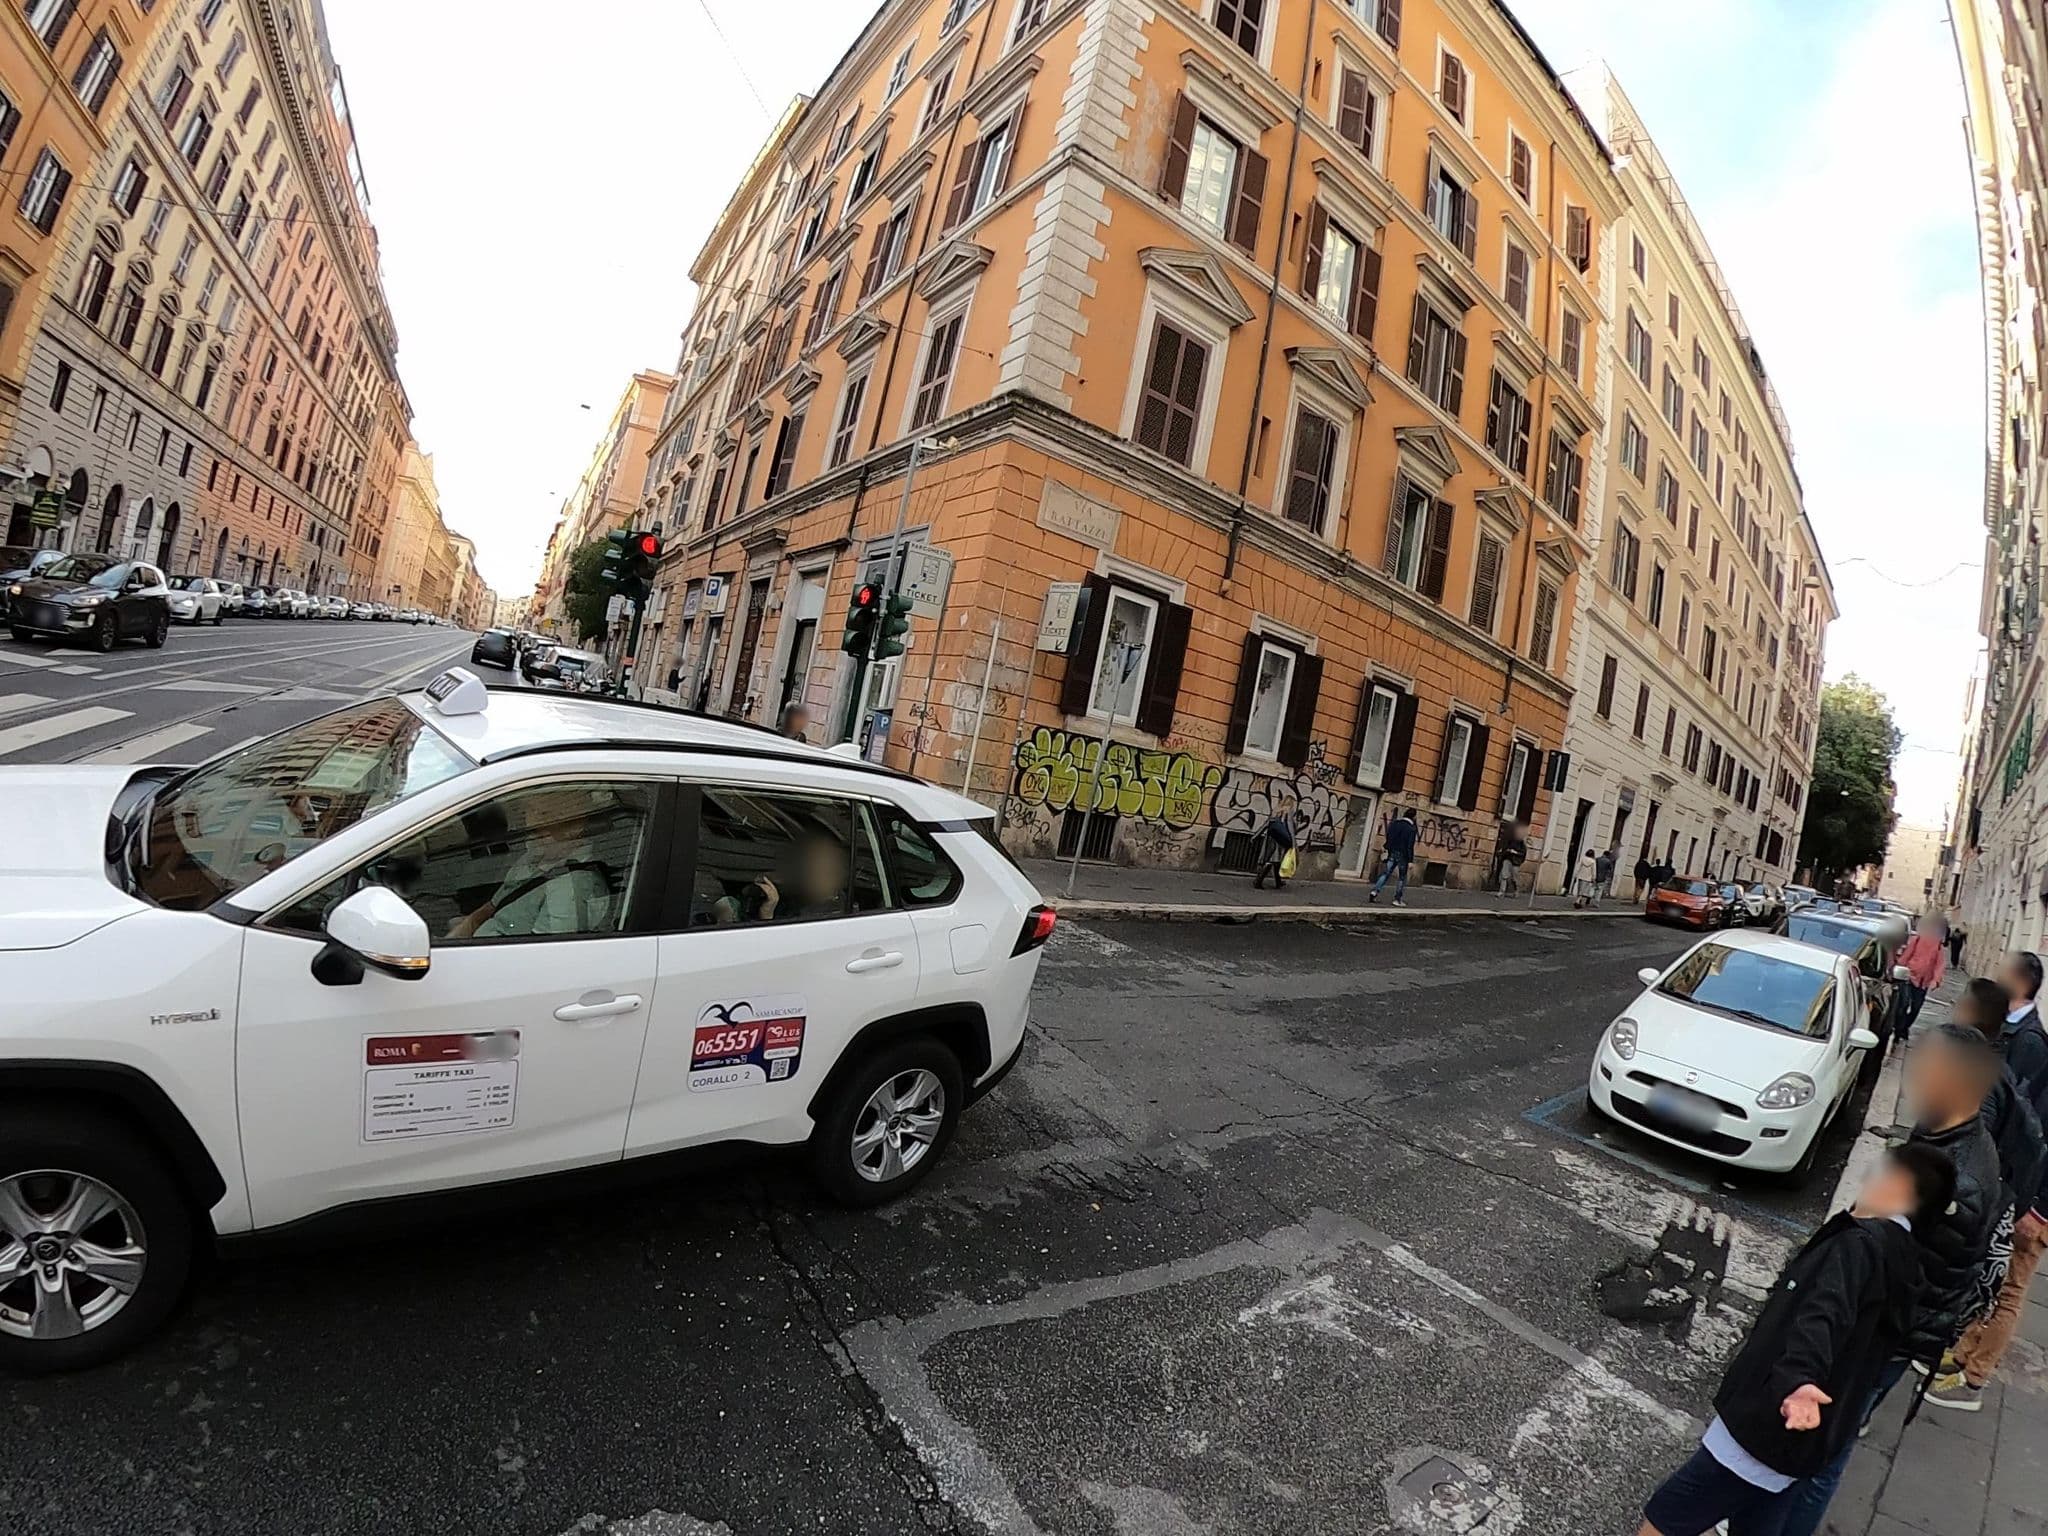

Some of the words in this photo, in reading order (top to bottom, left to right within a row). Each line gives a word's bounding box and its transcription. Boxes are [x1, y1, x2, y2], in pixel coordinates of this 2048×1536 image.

[1074, 500, 1093, 518] VIA
[906, 588, 938, 602] TICKET
[1043, 627, 1066, 635] TICKET
[695, 1029, 759, 1055] 065551
[374, 1048, 407, 1057] ROMA
[414, 1070, 451, 1079] TARIFFE
[454, 1068, 474, 1076] TAXI
[692, 1074, 738, 1087] CORALLO
[744, 1071, 751, 1080] 2
